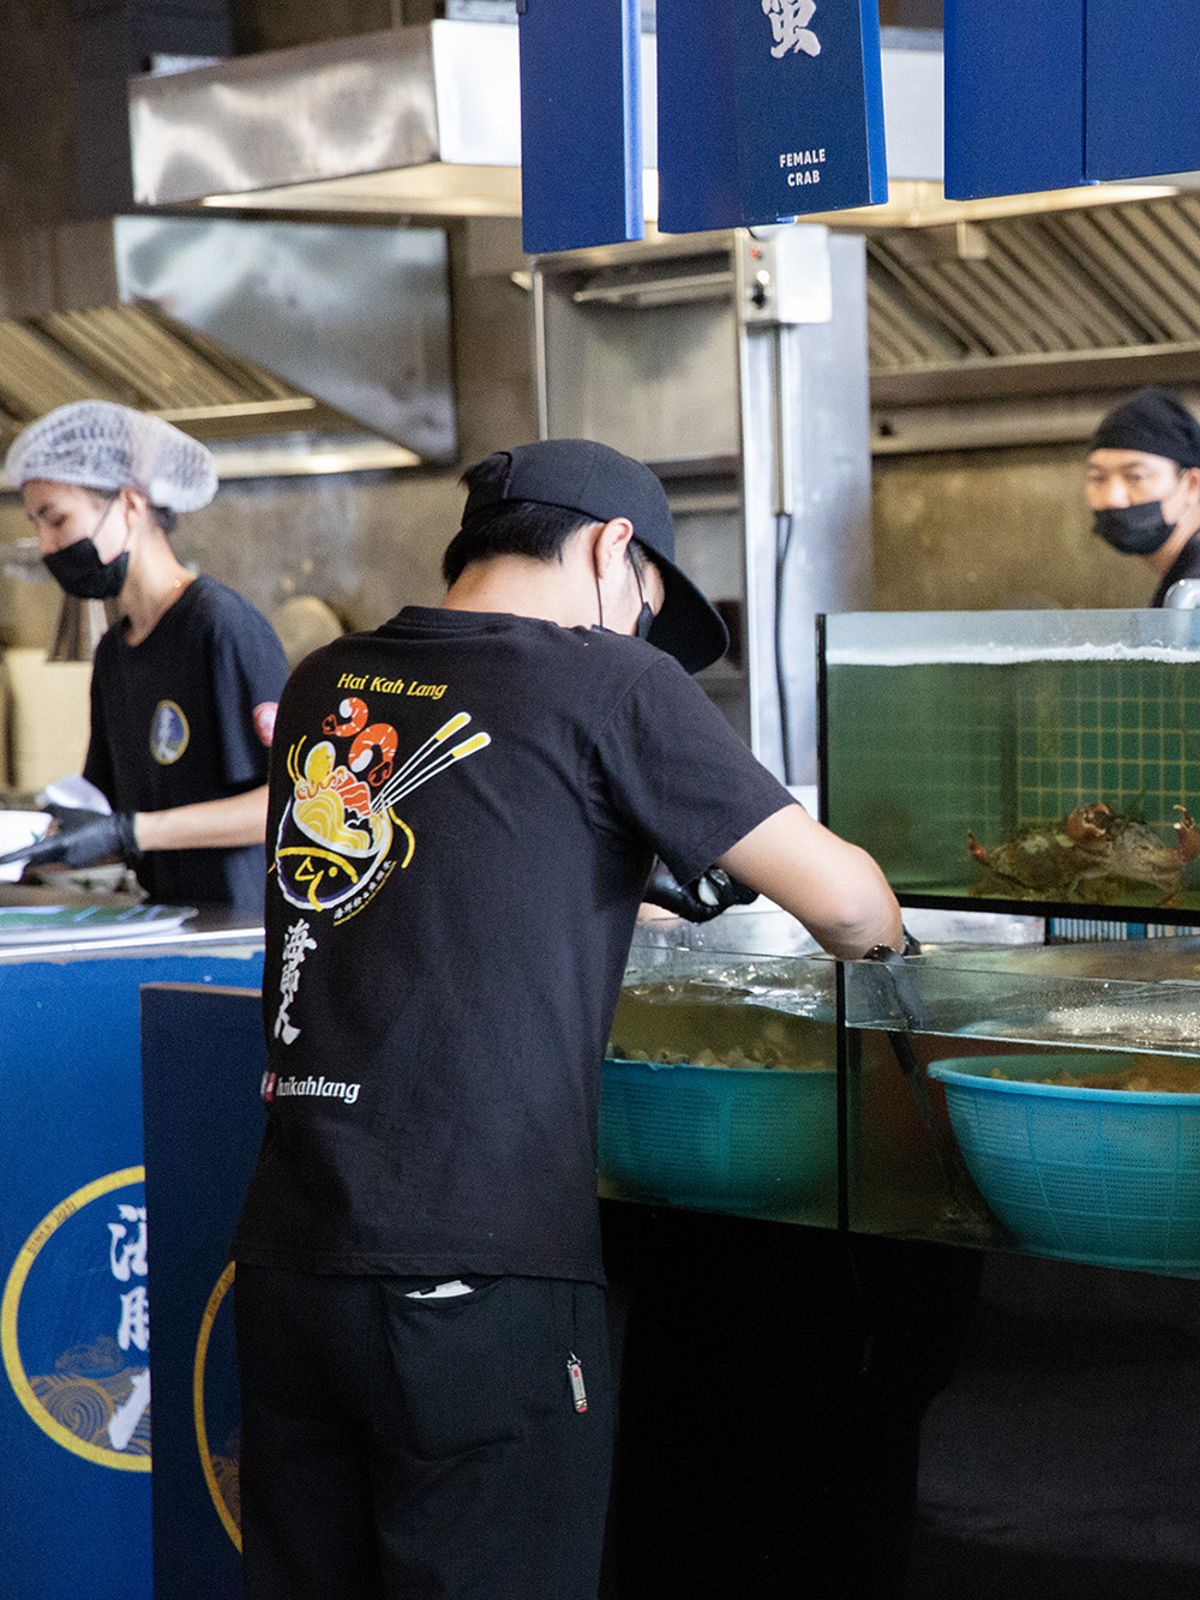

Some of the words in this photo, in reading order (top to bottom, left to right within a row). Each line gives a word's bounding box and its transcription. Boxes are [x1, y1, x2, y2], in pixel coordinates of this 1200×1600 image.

[779, 148, 827, 168] FEMALE
[787, 169, 821, 187] CRAB
[337, 673, 370, 690] Hai
[370, 676, 404, 695] Kah
[406, 681, 449, 700] Lang
